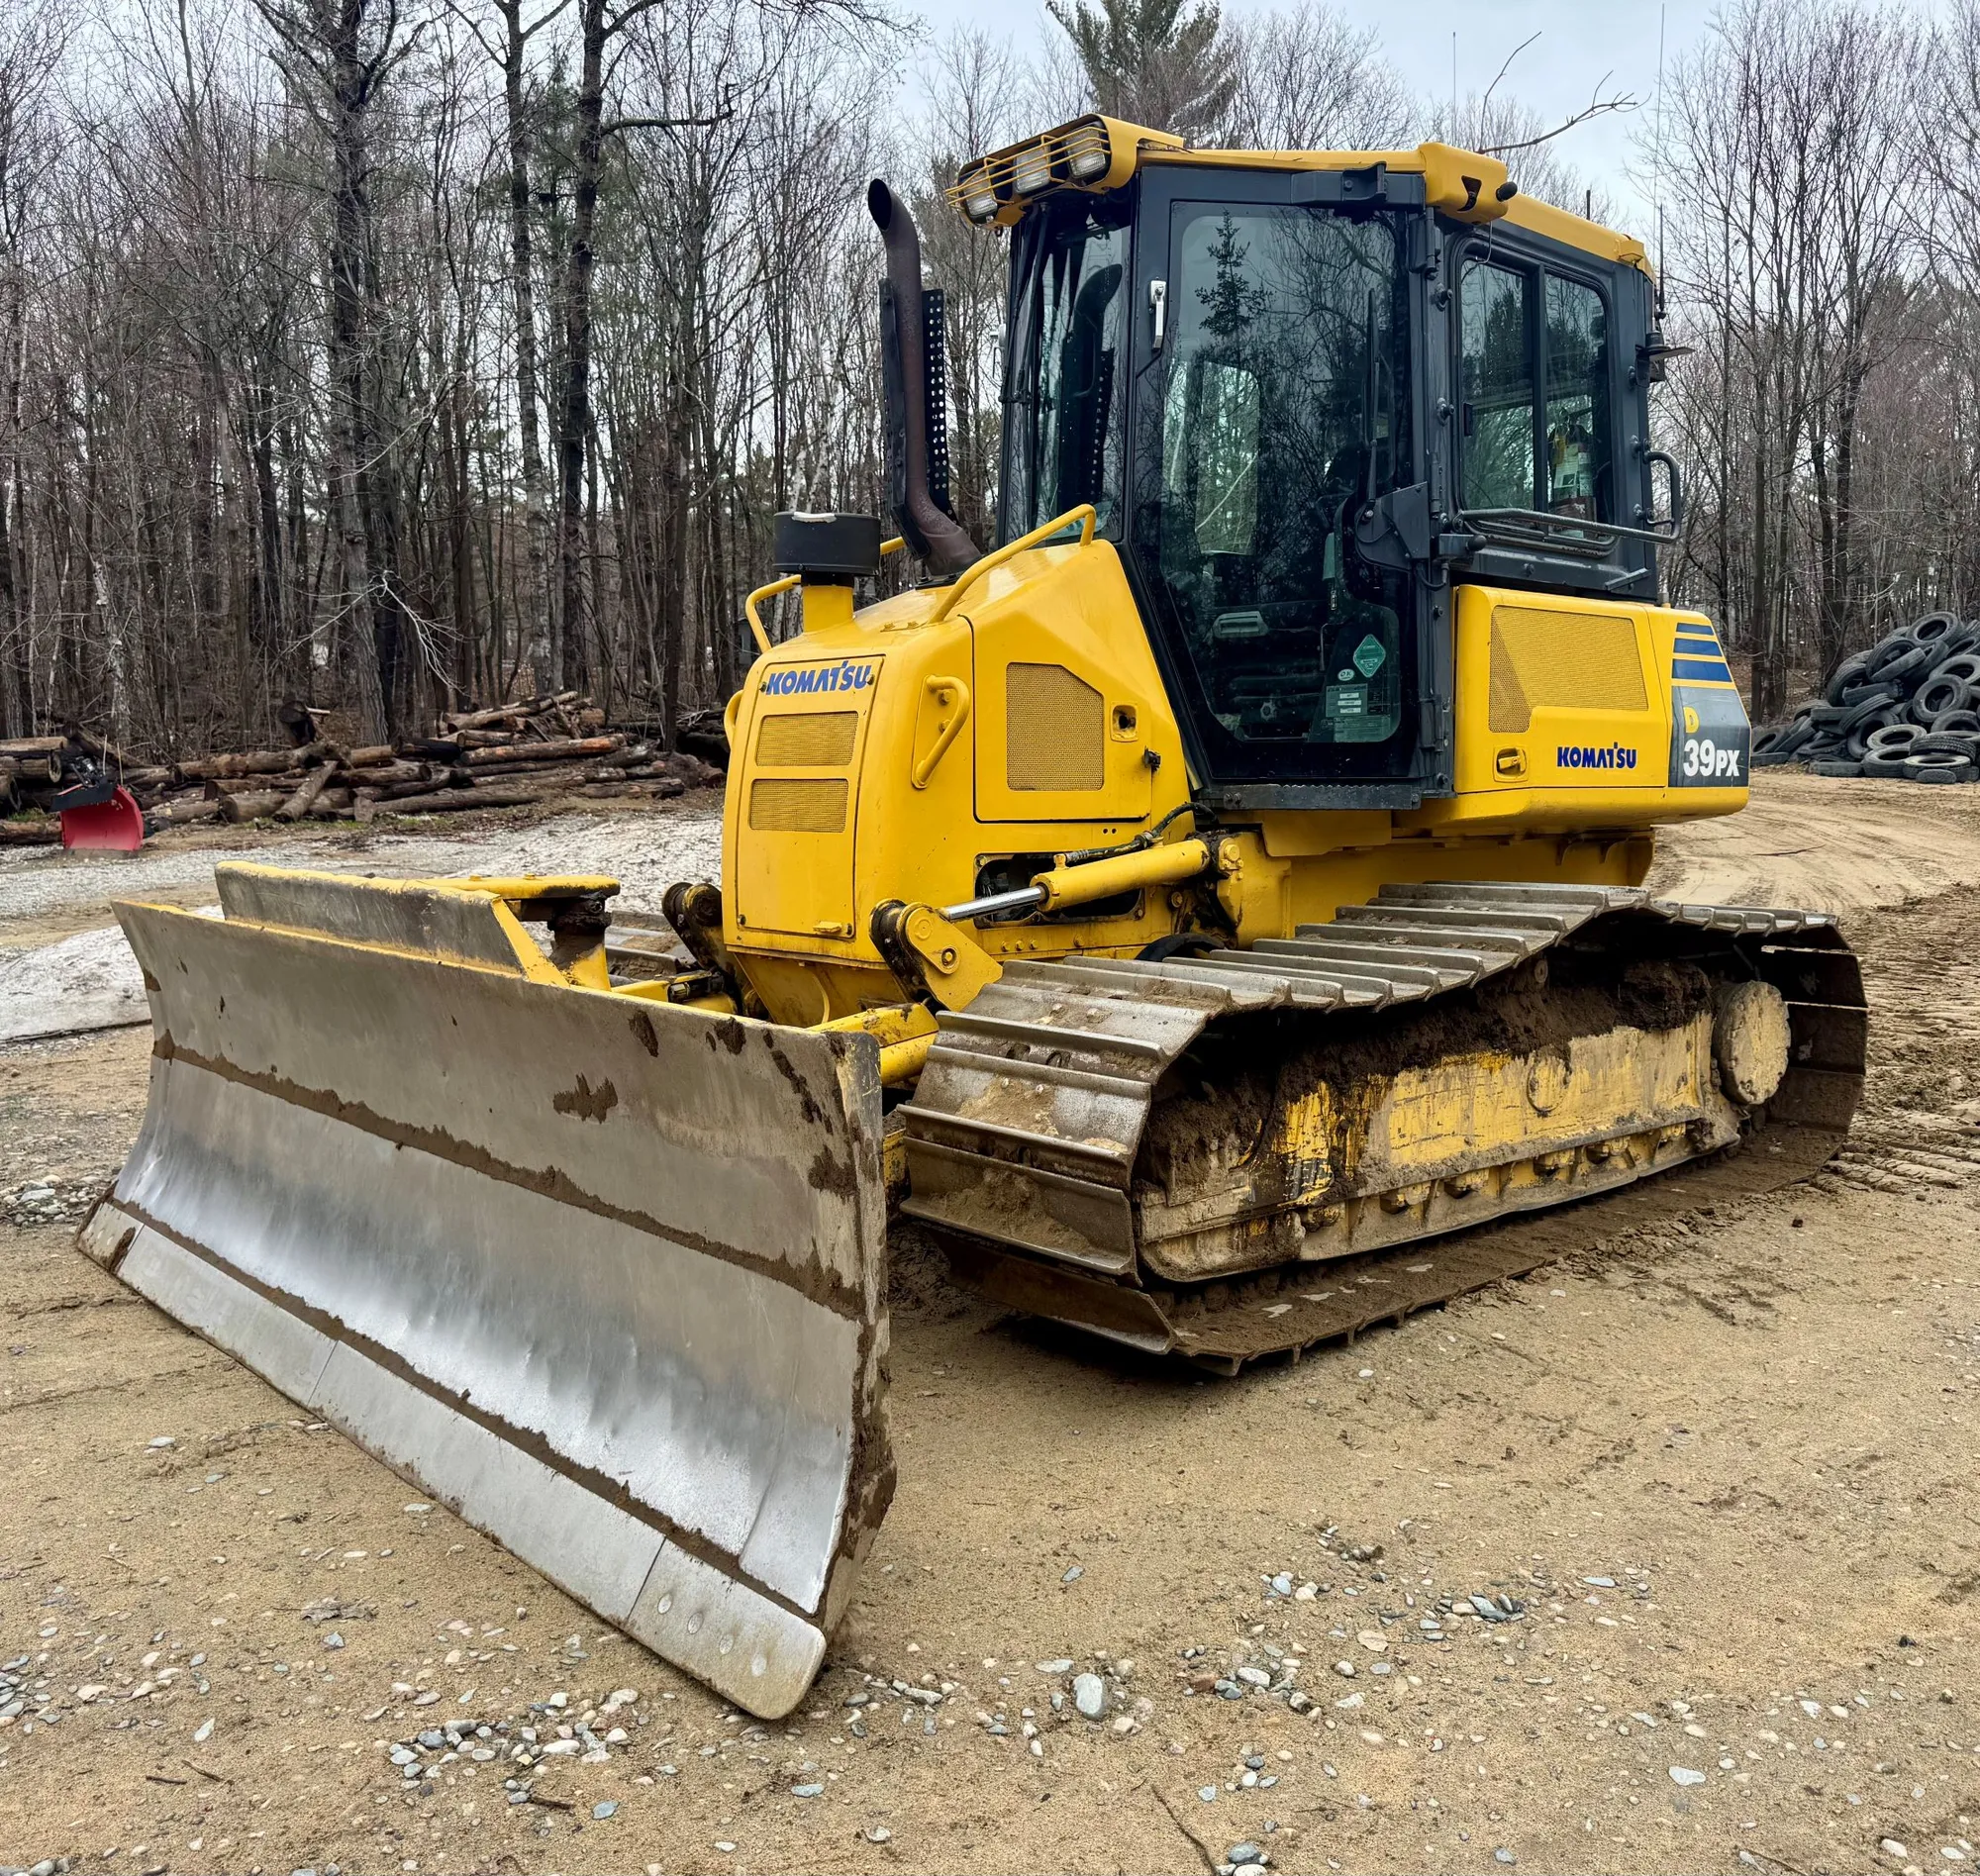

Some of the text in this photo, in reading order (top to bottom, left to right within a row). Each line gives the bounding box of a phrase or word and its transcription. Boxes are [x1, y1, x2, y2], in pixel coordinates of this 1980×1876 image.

[765, 660, 872, 695] KOMATSU
[1683, 707, 1700, 734] D
[1557, 741, 1636, 769] KOMATSU
[1683, 740, 1740, 777] 39PX
